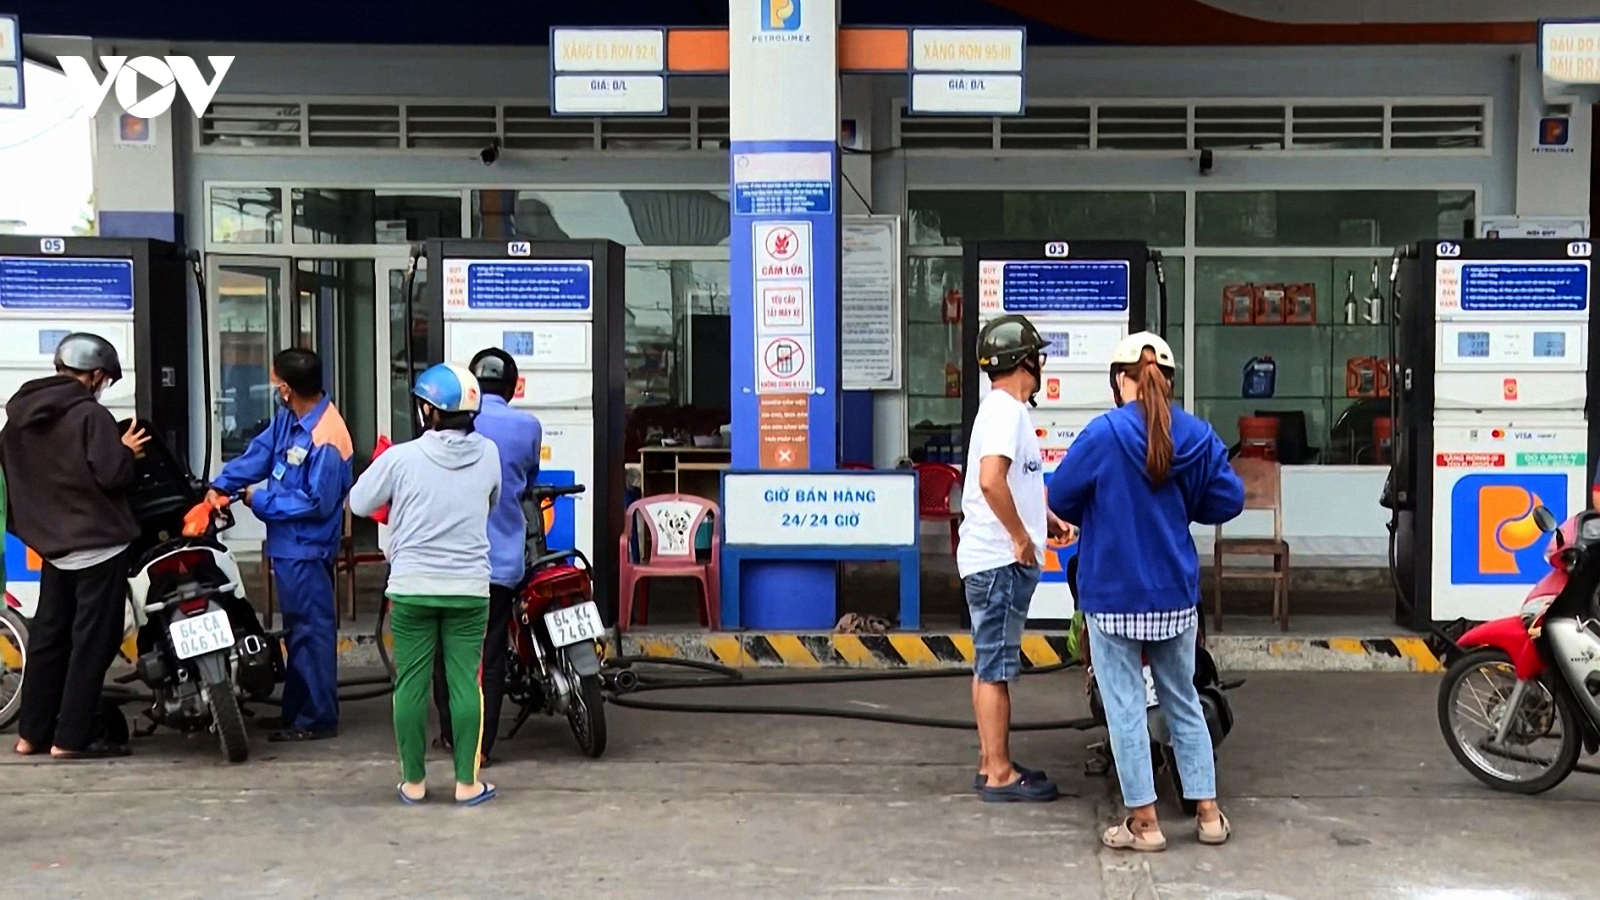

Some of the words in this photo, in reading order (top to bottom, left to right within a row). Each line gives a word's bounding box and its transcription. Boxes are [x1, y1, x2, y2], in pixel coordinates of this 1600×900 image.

[751, 34, 811, 43] PETROLIMEX
[611, 44, 633, 60] RON
[958, 44, 982, 60] RON
[44, 240, 62, 251] 05
[511, 243, 528, 254] 04
[1049, 244, 1065, 255] 03
[1440, 244, 1457, 255] 02
[1572, 243, 1588, 255] 01
[761, 264, 783, 276] CẤM
[764, 486, 790, 502] GIỜ
[795, 487, 828, 503] BÁN
[833, 487, 876, 503] HÀNG
[782, 513, 829, 528] 24/24
[834, 511, 860, 527] GIỜ
[553, 605, 591, 627] 64-K4
[180, 614, 220, 639] 64-CA
[558, 621, 595, 642] 7461
